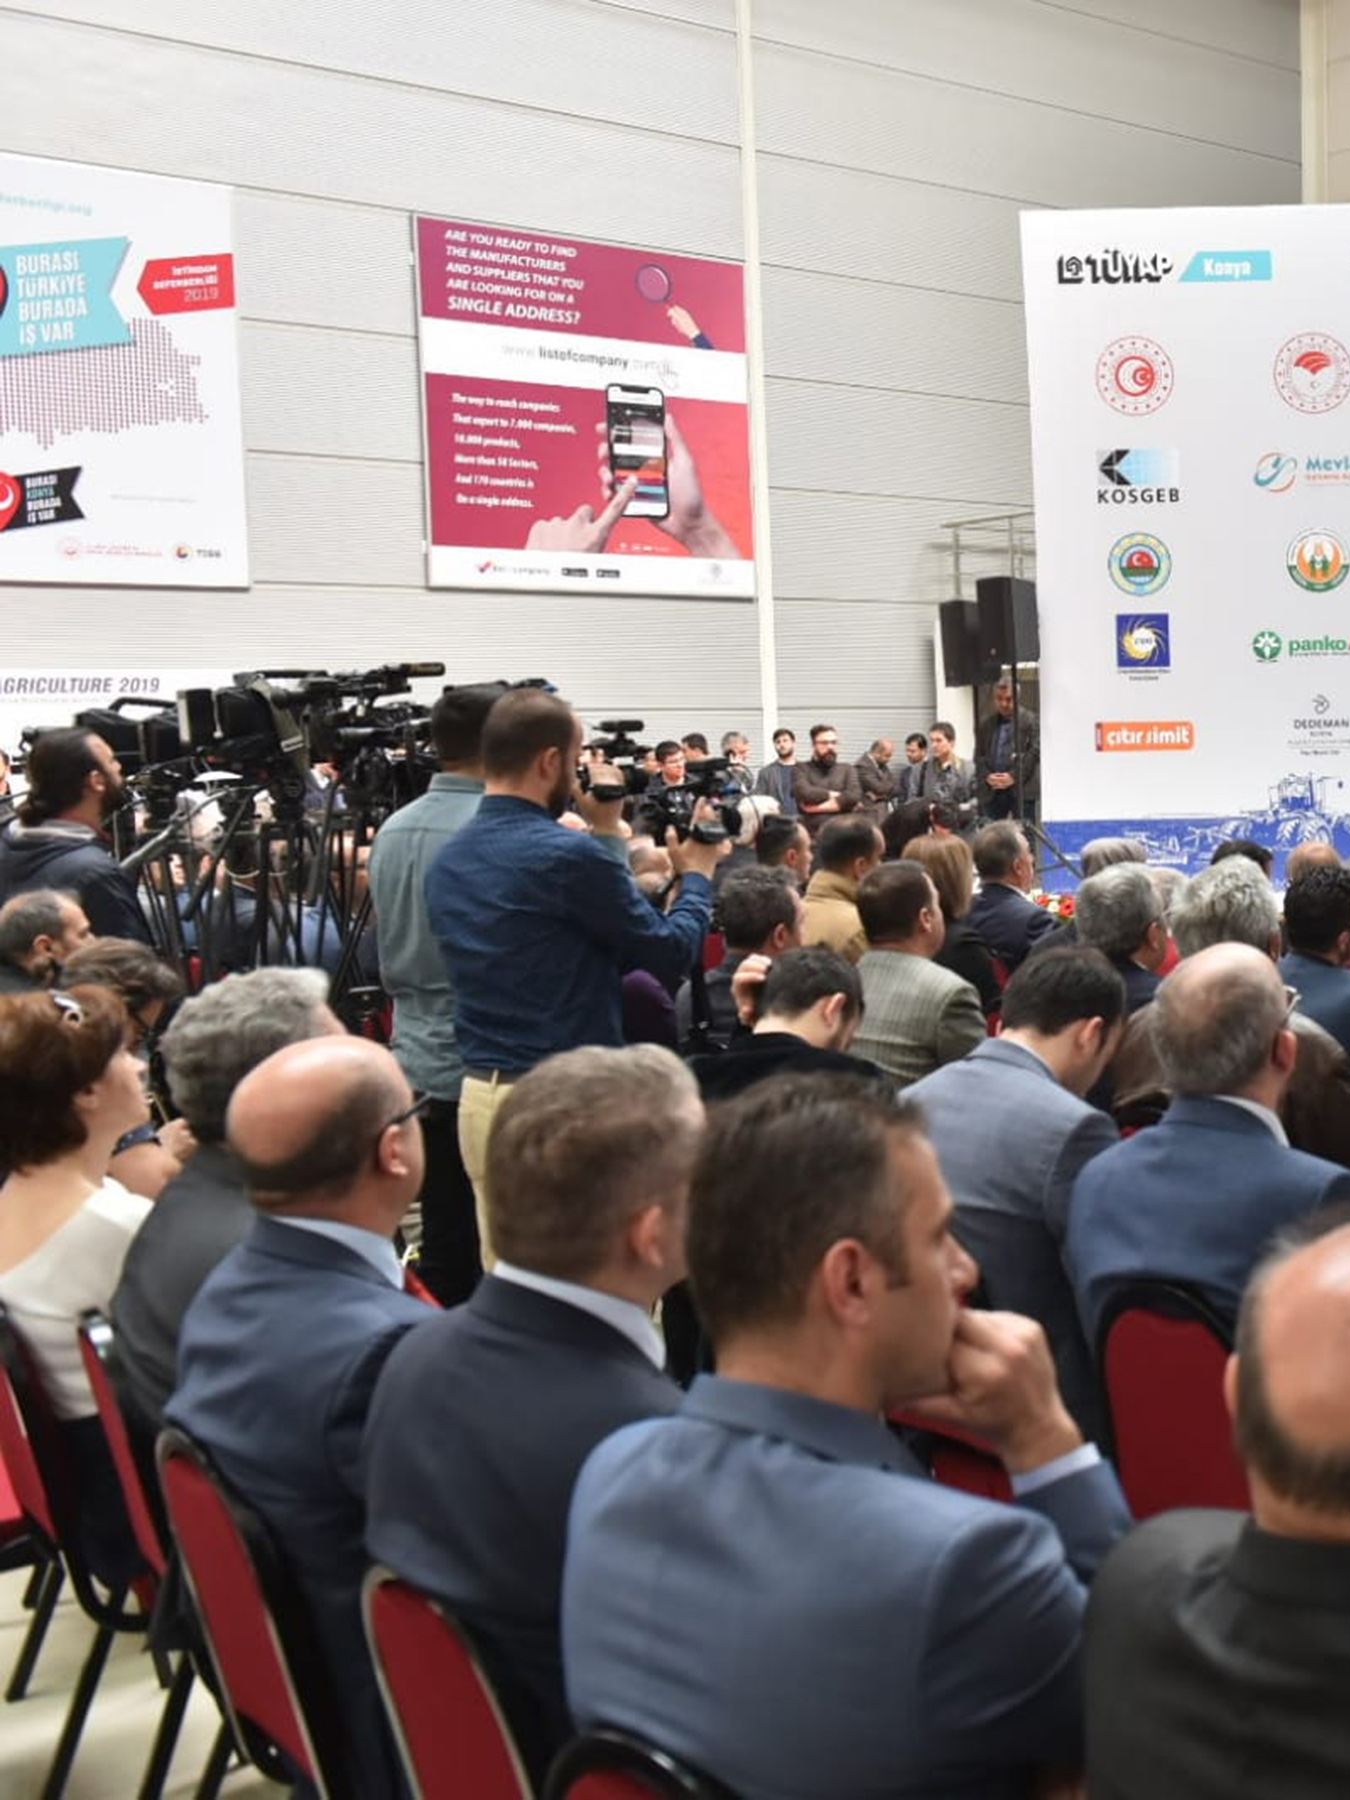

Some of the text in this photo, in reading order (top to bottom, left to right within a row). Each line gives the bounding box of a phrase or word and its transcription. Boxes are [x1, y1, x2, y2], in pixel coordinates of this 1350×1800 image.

[445, 230, 577, 258] ARE YOU READY TO FIND
[446, 246, 566, 272] THE MANUFACTURERS
[1086, 248, 1173, 285] TÜYAP
[1203, 257, 1251, 279] Konya
[446, 263, 584, 290] AND SUPPLIERS THAT YOU
[185, 287, 218, 302] 2019
[446, 279, 575, 304] ARE LOOKING FOR ON A
[19, 297, 88, 322] BURADA
[448, 296, 581, 325] SINGLE ADDRESS?
[41, 320, 74, 343] VAR
[454, 454, 475, 465] More
[1097, 487, 1180, 505] KOSGEB
[119, 677, 160, 694] 2019
[1293, 718, 1350, 729] DEDEMAN
[1106, 724, 1190, 747] çıtır simit
